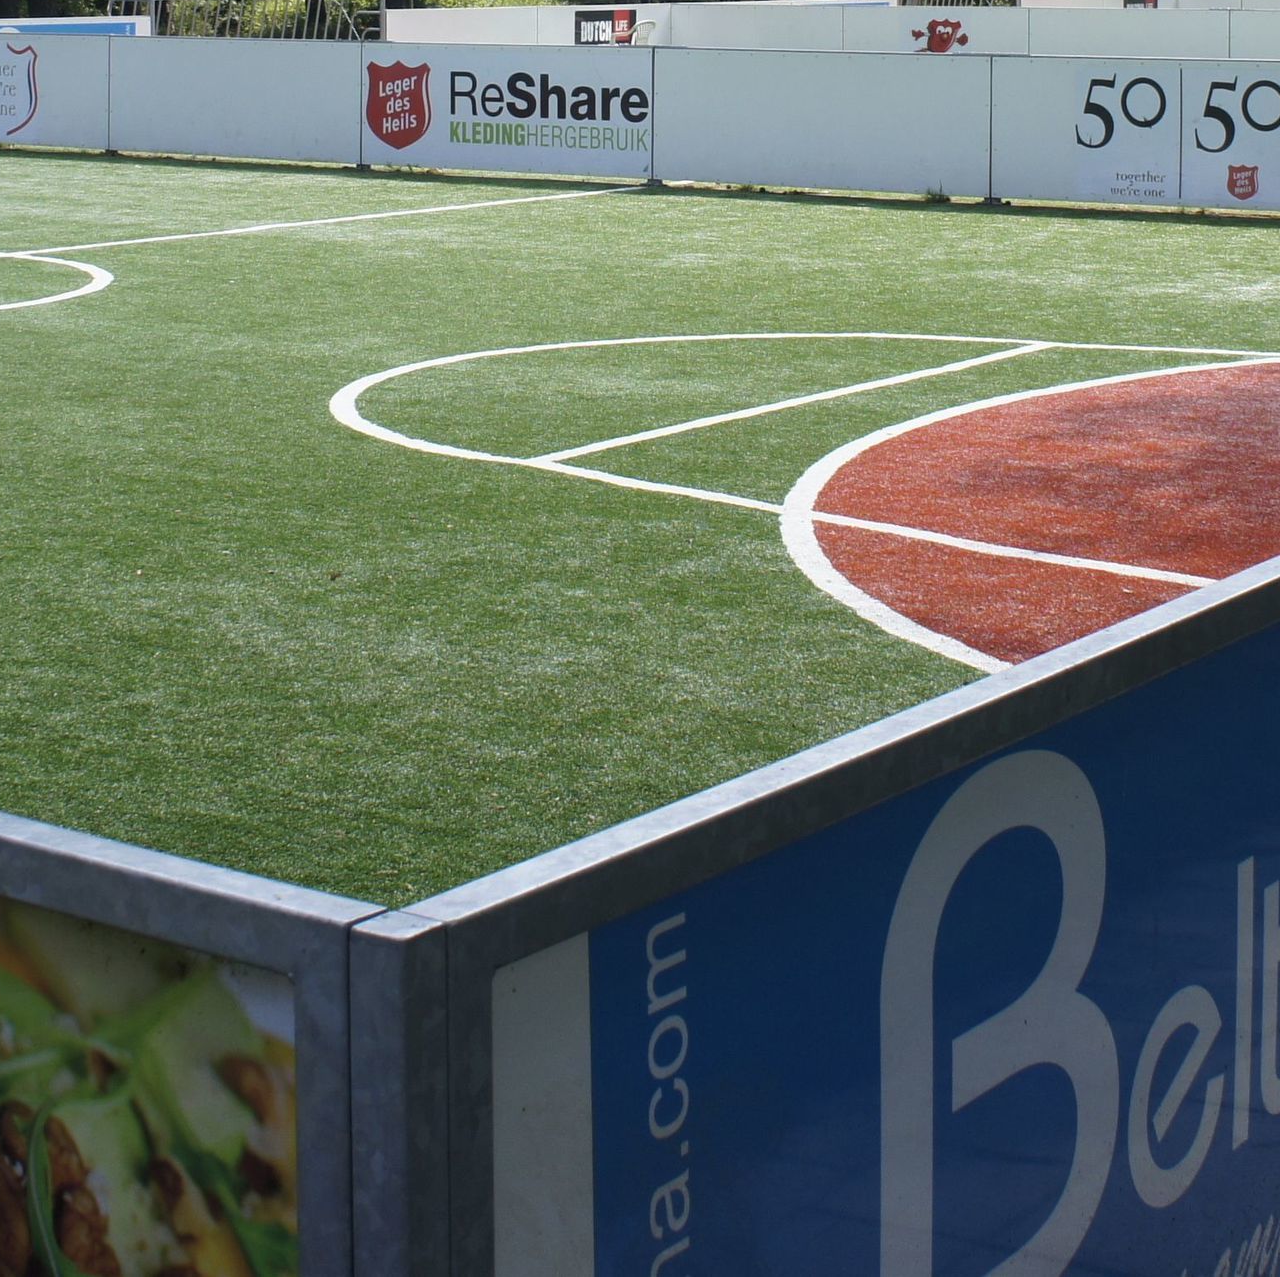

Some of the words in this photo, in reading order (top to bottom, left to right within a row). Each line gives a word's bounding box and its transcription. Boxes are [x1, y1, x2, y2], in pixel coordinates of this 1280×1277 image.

[379, 76, 417, 98] Leger
[449, 71, 649, 123] ReShare
[386, 96, 410, 115] des
[1075, 73, 1167, 149] 50
[382, 114, 417, 134] Heils
[449, 121, 649, 151] KLEDINGHERGEBRUIK
[1116, 172, 1166, 187] together
[1232, 172, 1253, 183] Leger
[1110, 186, 1139, 197] we're
[1143, 188, 1165, 198] one
